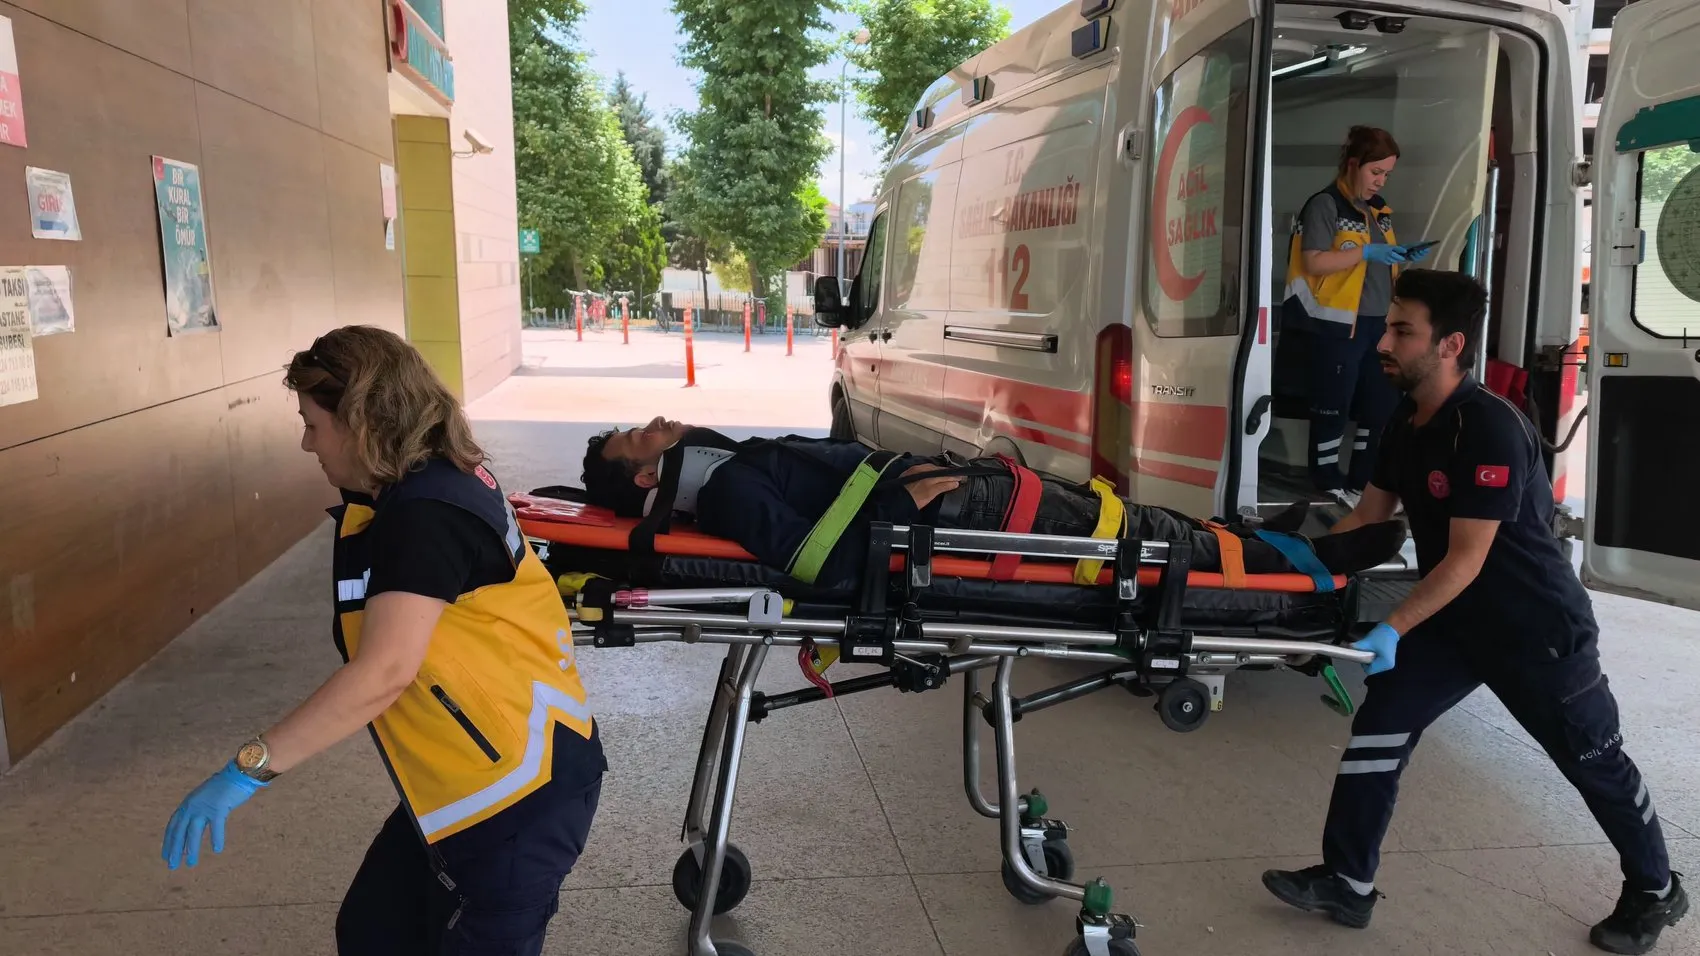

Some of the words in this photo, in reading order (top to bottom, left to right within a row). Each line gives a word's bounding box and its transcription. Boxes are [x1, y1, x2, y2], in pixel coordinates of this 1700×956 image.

[168, 186, 192, 206] KURAL
[175, 224, 196, 246] ÖMÜR
[986, 244, 1031, 311] 112
[1151, 384, 1197, 397] TRANSIT
